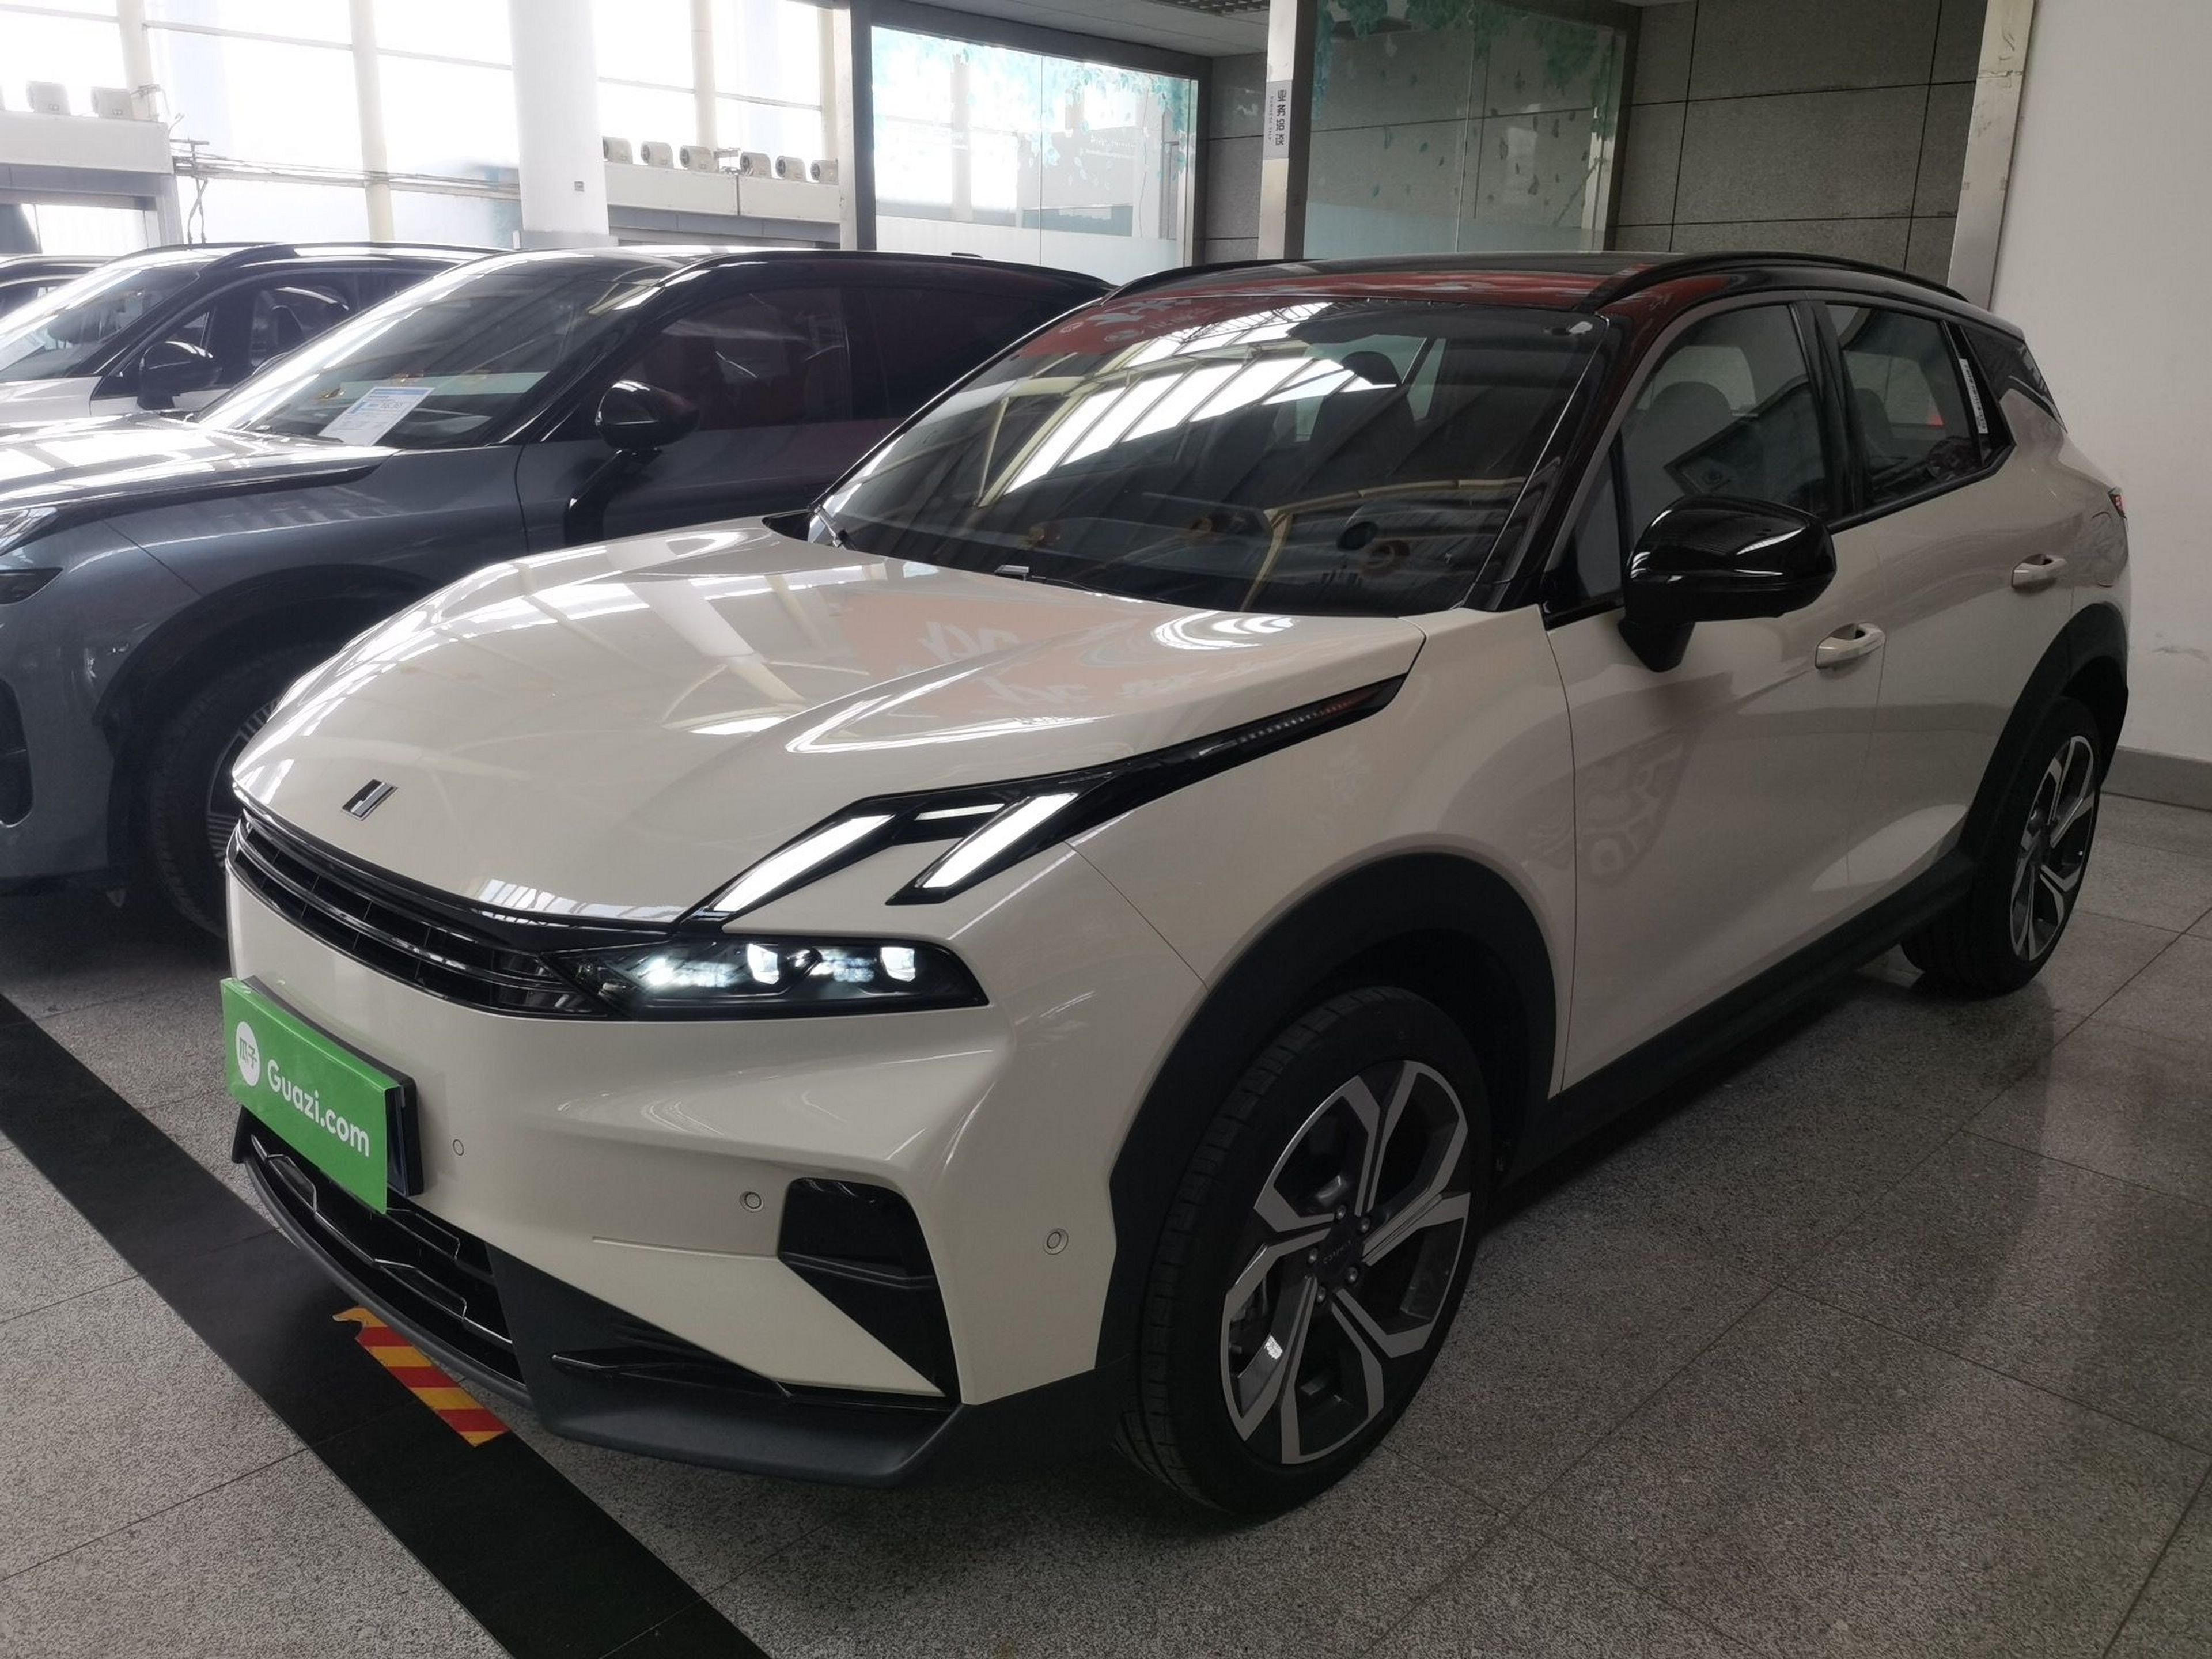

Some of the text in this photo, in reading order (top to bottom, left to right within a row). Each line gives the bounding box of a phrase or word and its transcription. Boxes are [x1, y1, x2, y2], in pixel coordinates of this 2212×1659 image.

[1276, 89, 1287, 145] 业务洽谈
[267, 1059, 370, 1157] Guazi.com
